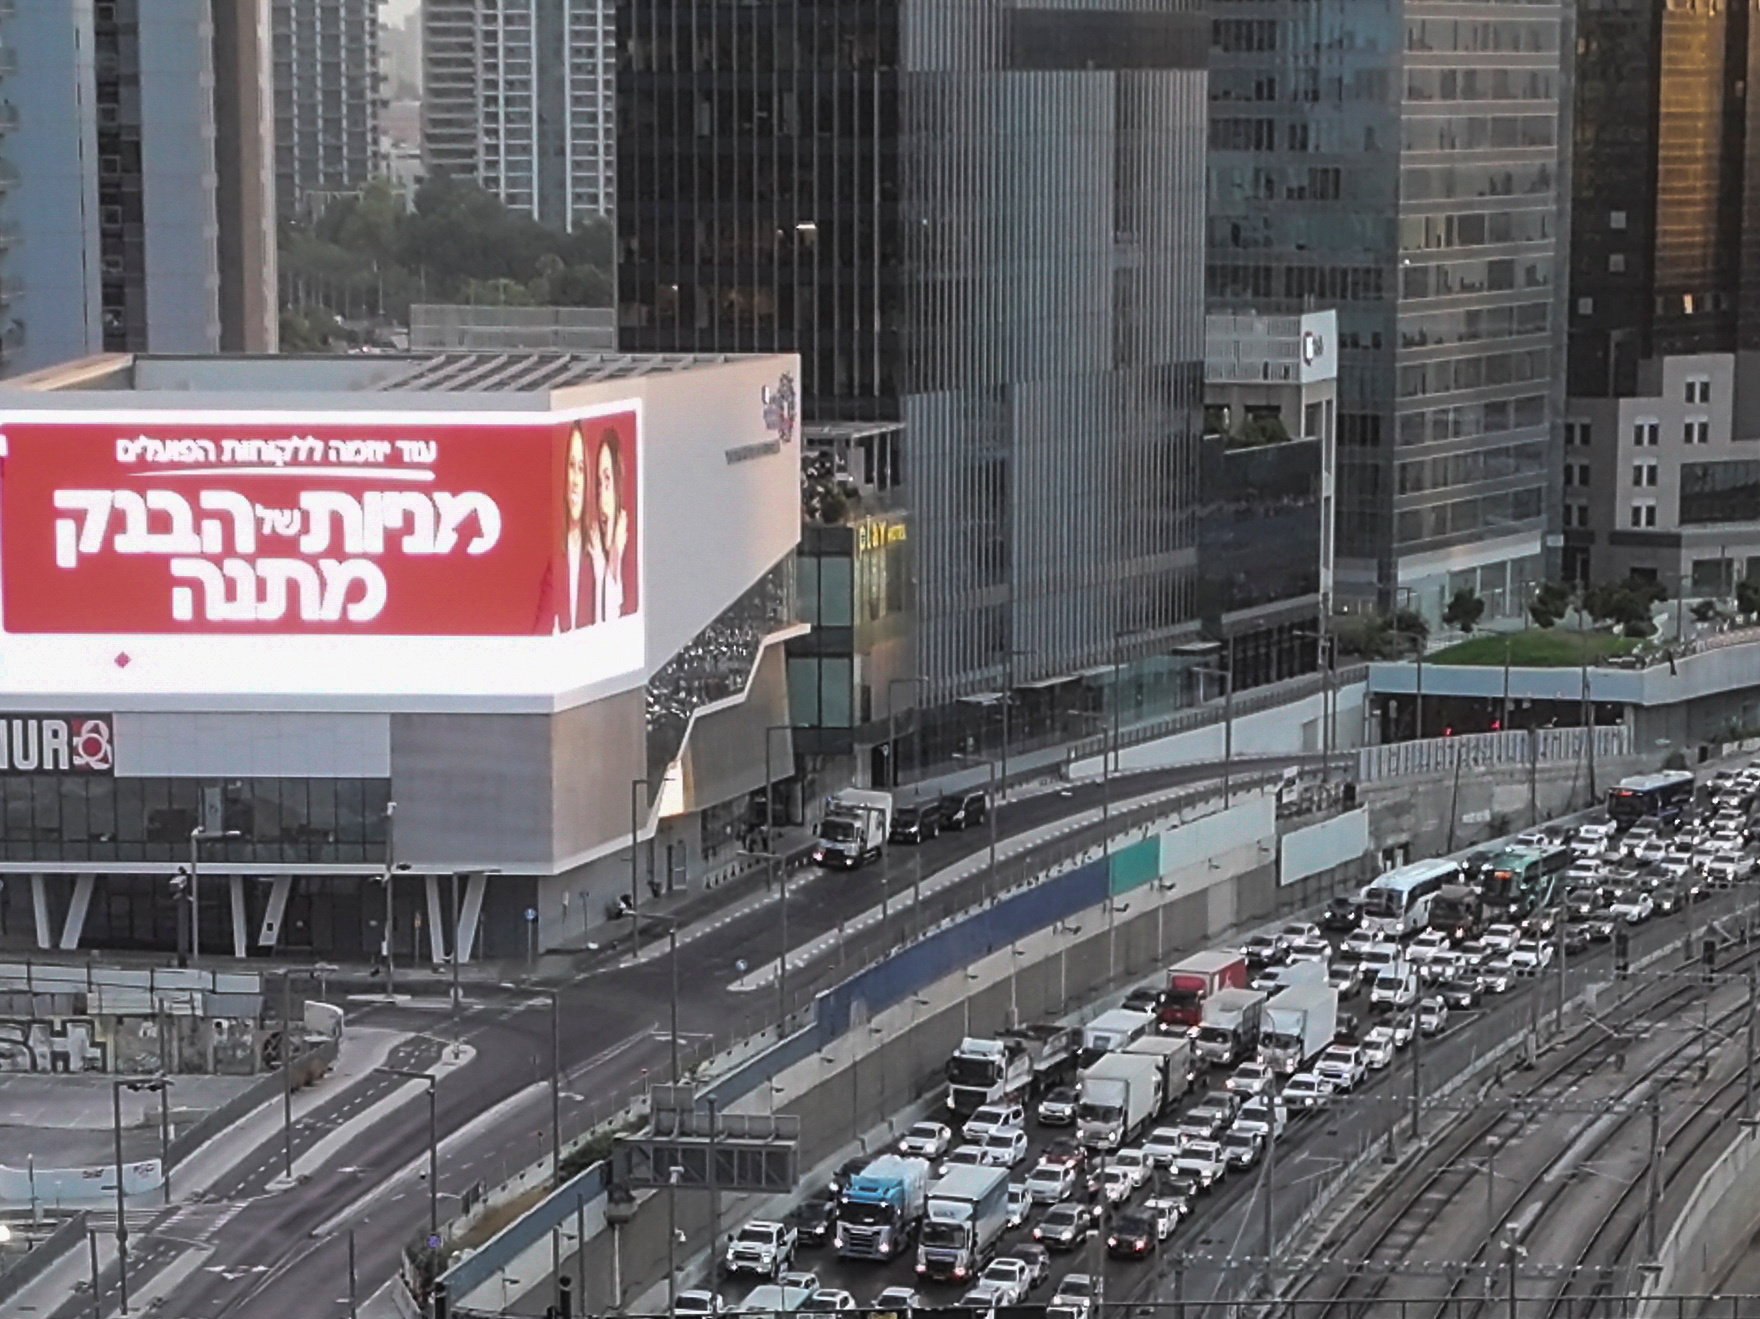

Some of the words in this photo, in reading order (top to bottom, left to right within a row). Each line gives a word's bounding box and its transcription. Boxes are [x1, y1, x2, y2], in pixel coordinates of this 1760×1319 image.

[115, 434, 216, 462] הפועלים
[221, 434, 325, 466] ללקוחות
[395, 438, 437, 463] עוד
[53, 489, 257, 569] הבנק
[255, 503, 300, 535] של
[298, 490, 502, 555] מניות
[169, 557, 388, 623] מתנה
